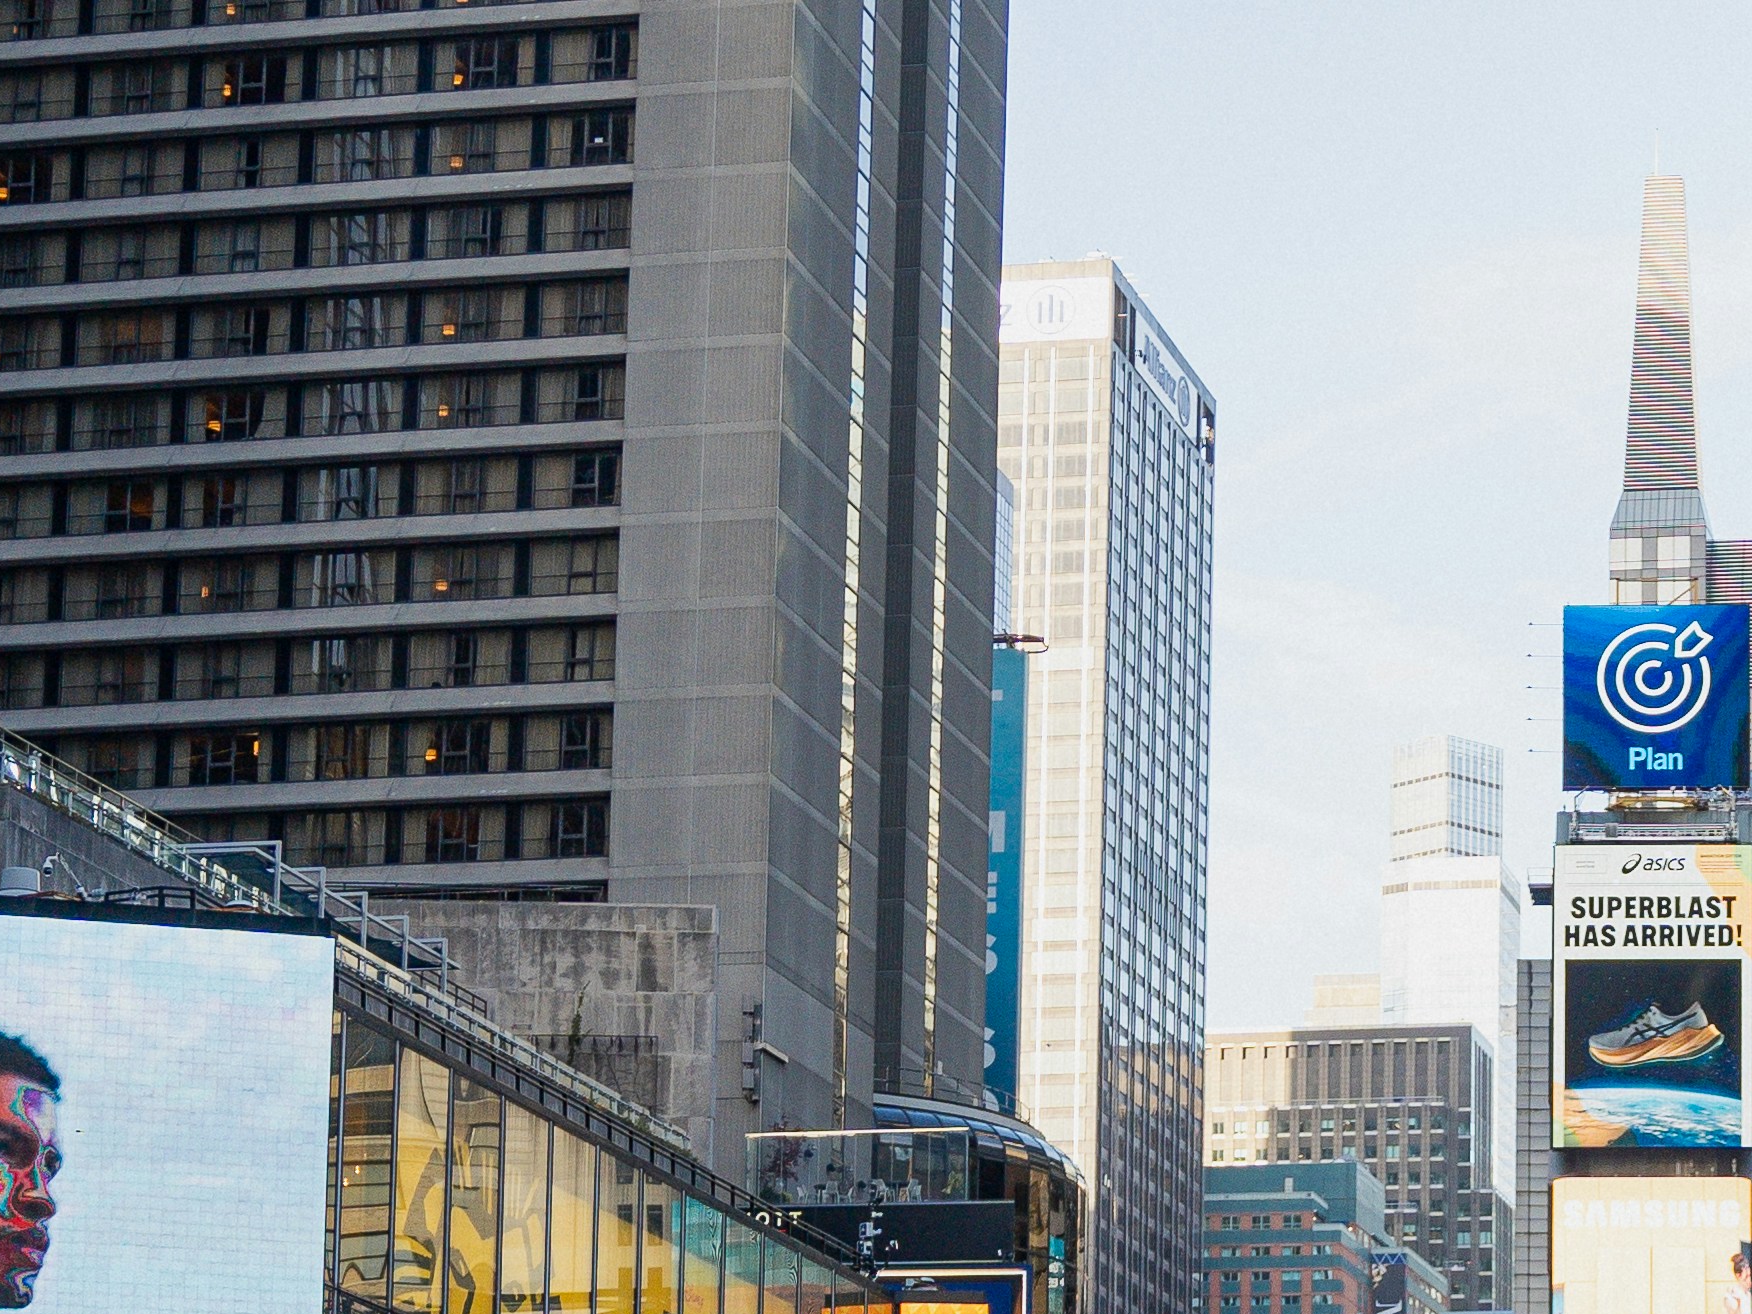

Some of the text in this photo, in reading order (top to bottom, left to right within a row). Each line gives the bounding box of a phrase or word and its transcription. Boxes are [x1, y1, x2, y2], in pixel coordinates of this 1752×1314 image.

[1628, 747, 1683, 772] Plan
[1643, 858, 1686, 872] asics
[1571, 895, 1737, 919] SUPERBLAST
[1564, 924, 1743, 947] HAS ARRIVED!
[1562, 1199, 1741, 1229] SAMSUNG
